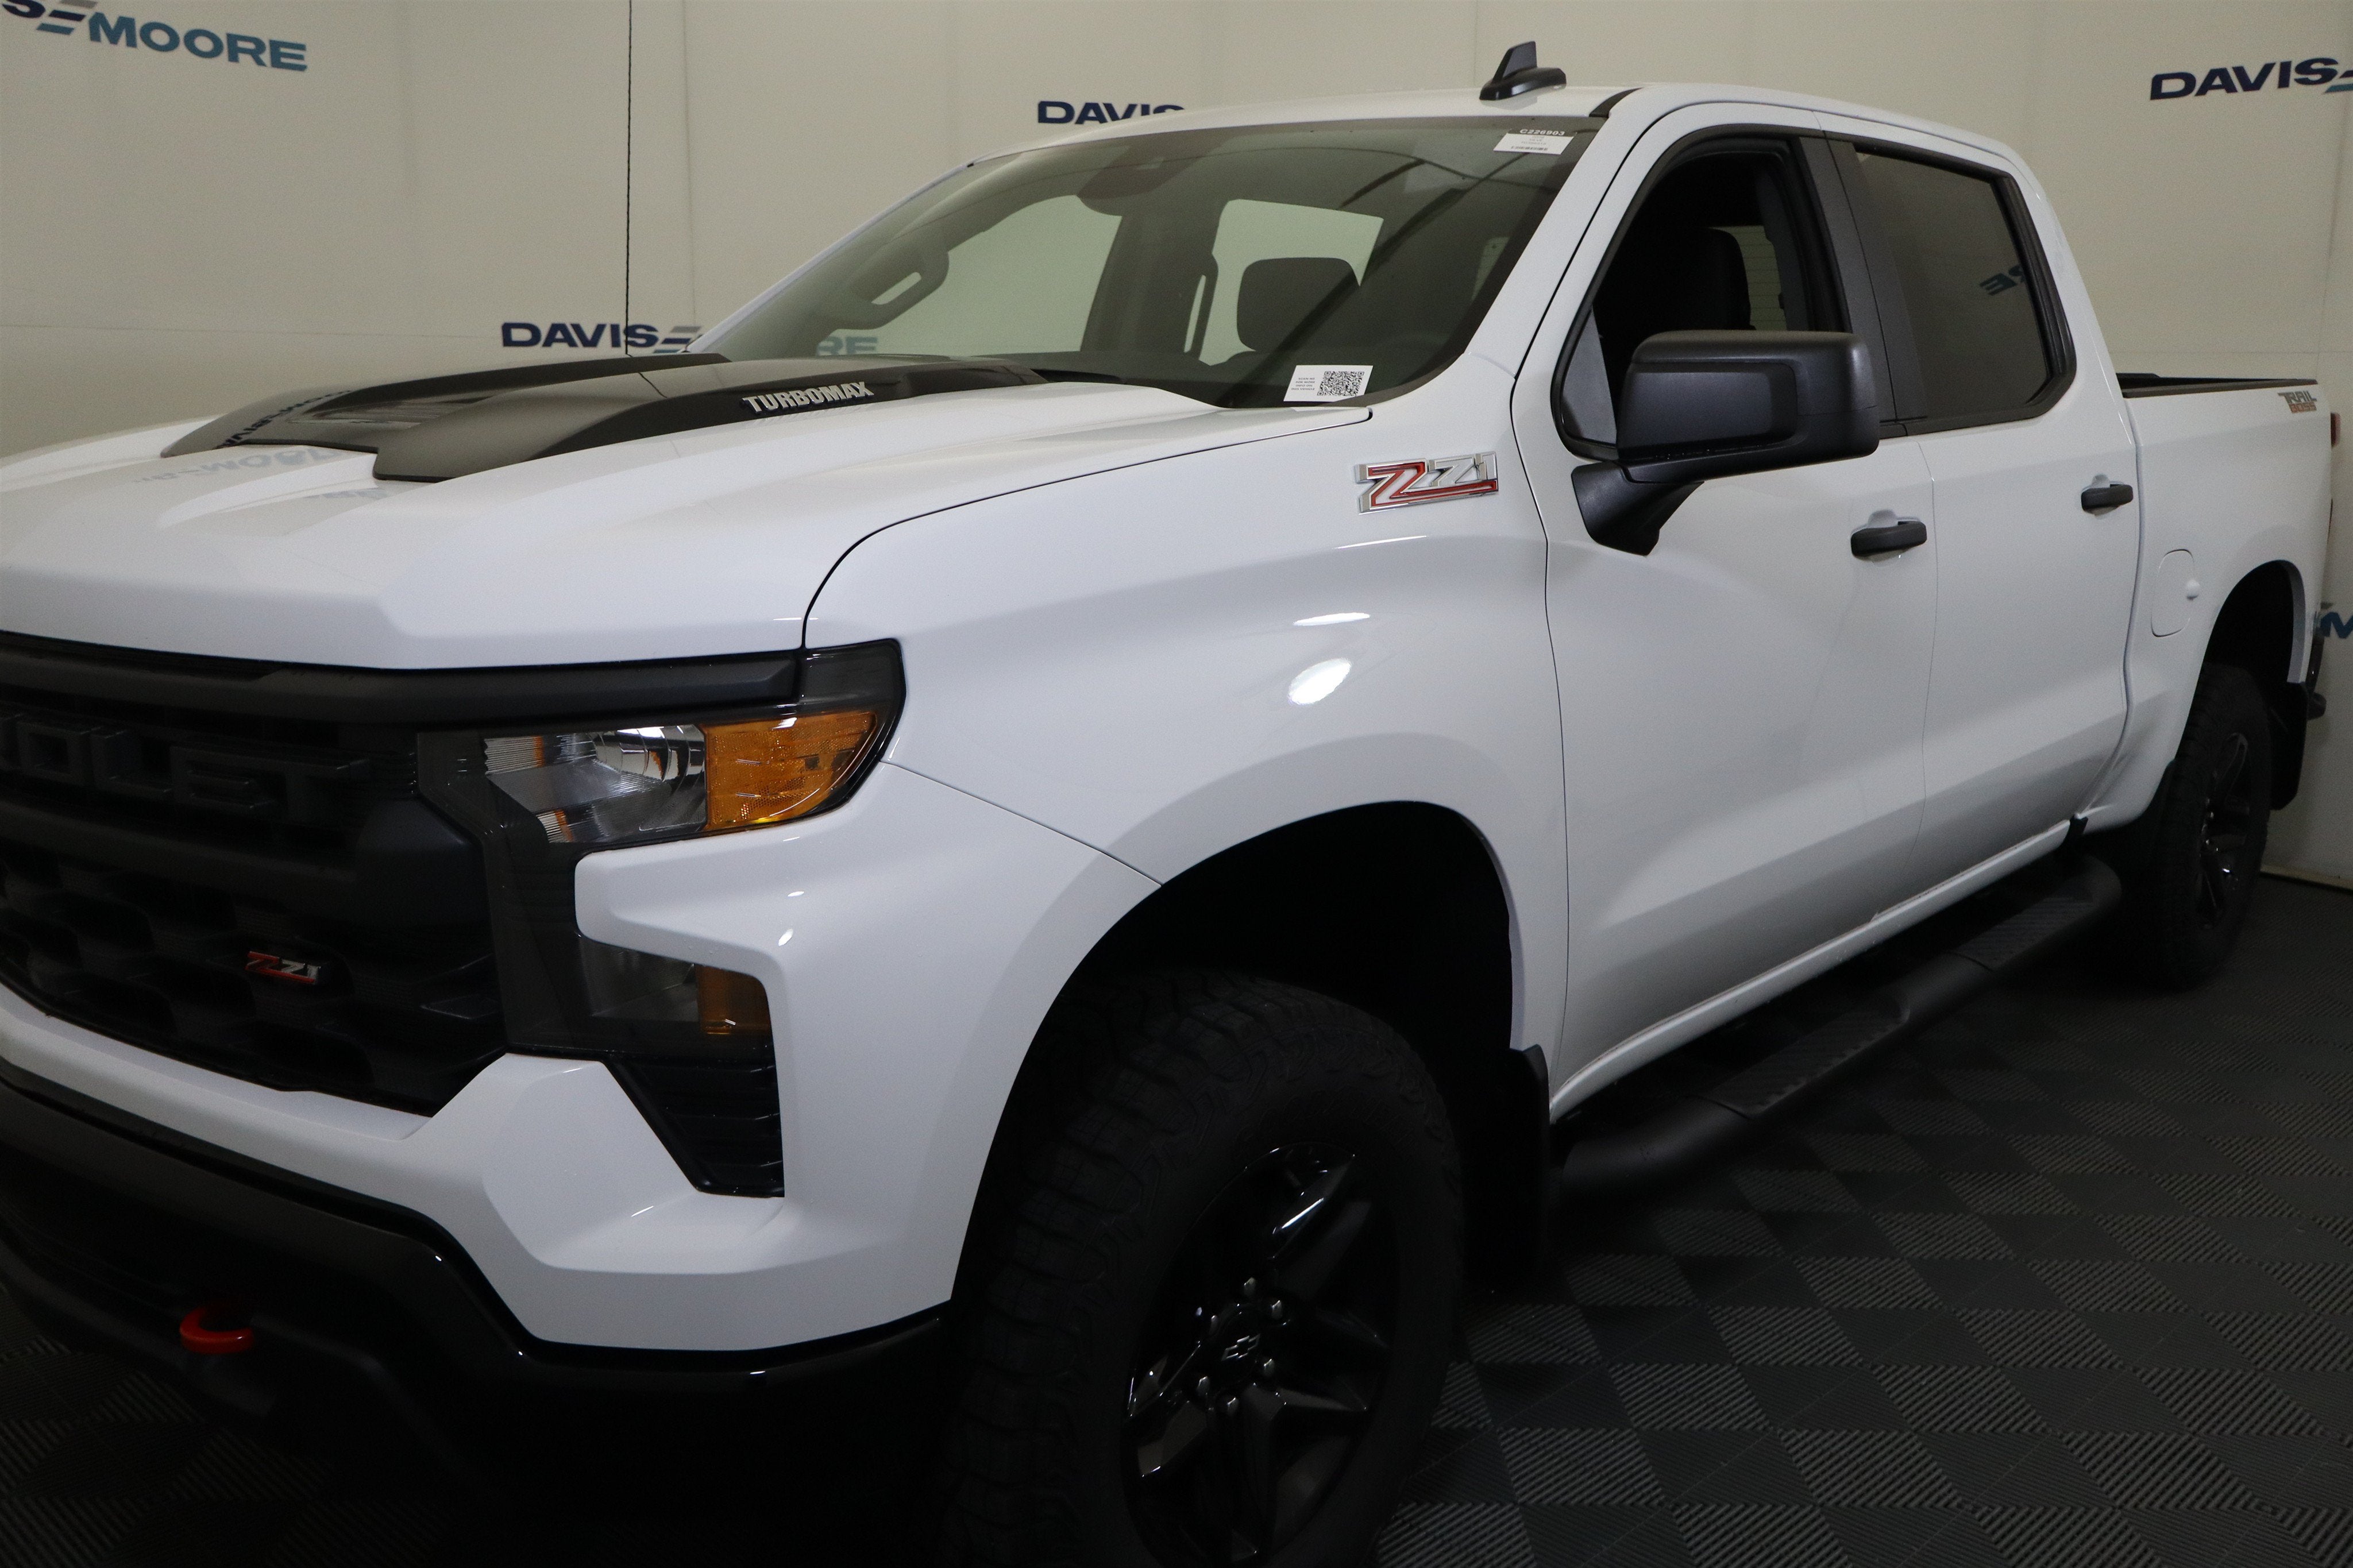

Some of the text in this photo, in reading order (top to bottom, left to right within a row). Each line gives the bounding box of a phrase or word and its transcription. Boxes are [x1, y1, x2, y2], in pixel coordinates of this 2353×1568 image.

[88, 11, 307, 71] MOORE
[2150, 57, 2338, 101] DAVIS
[502, 322, 659, 348] DAVIS
[741, 381, 874, 415] TURBOMAX
[2277, 391, 2317, 404] TRAIL
[2288, 401, 2317, 414] BOSS
[1355, 451, 1498, 515] Z71
[0, 714, 368, 821] OLET
[244, 951, 322, 984] Z71
